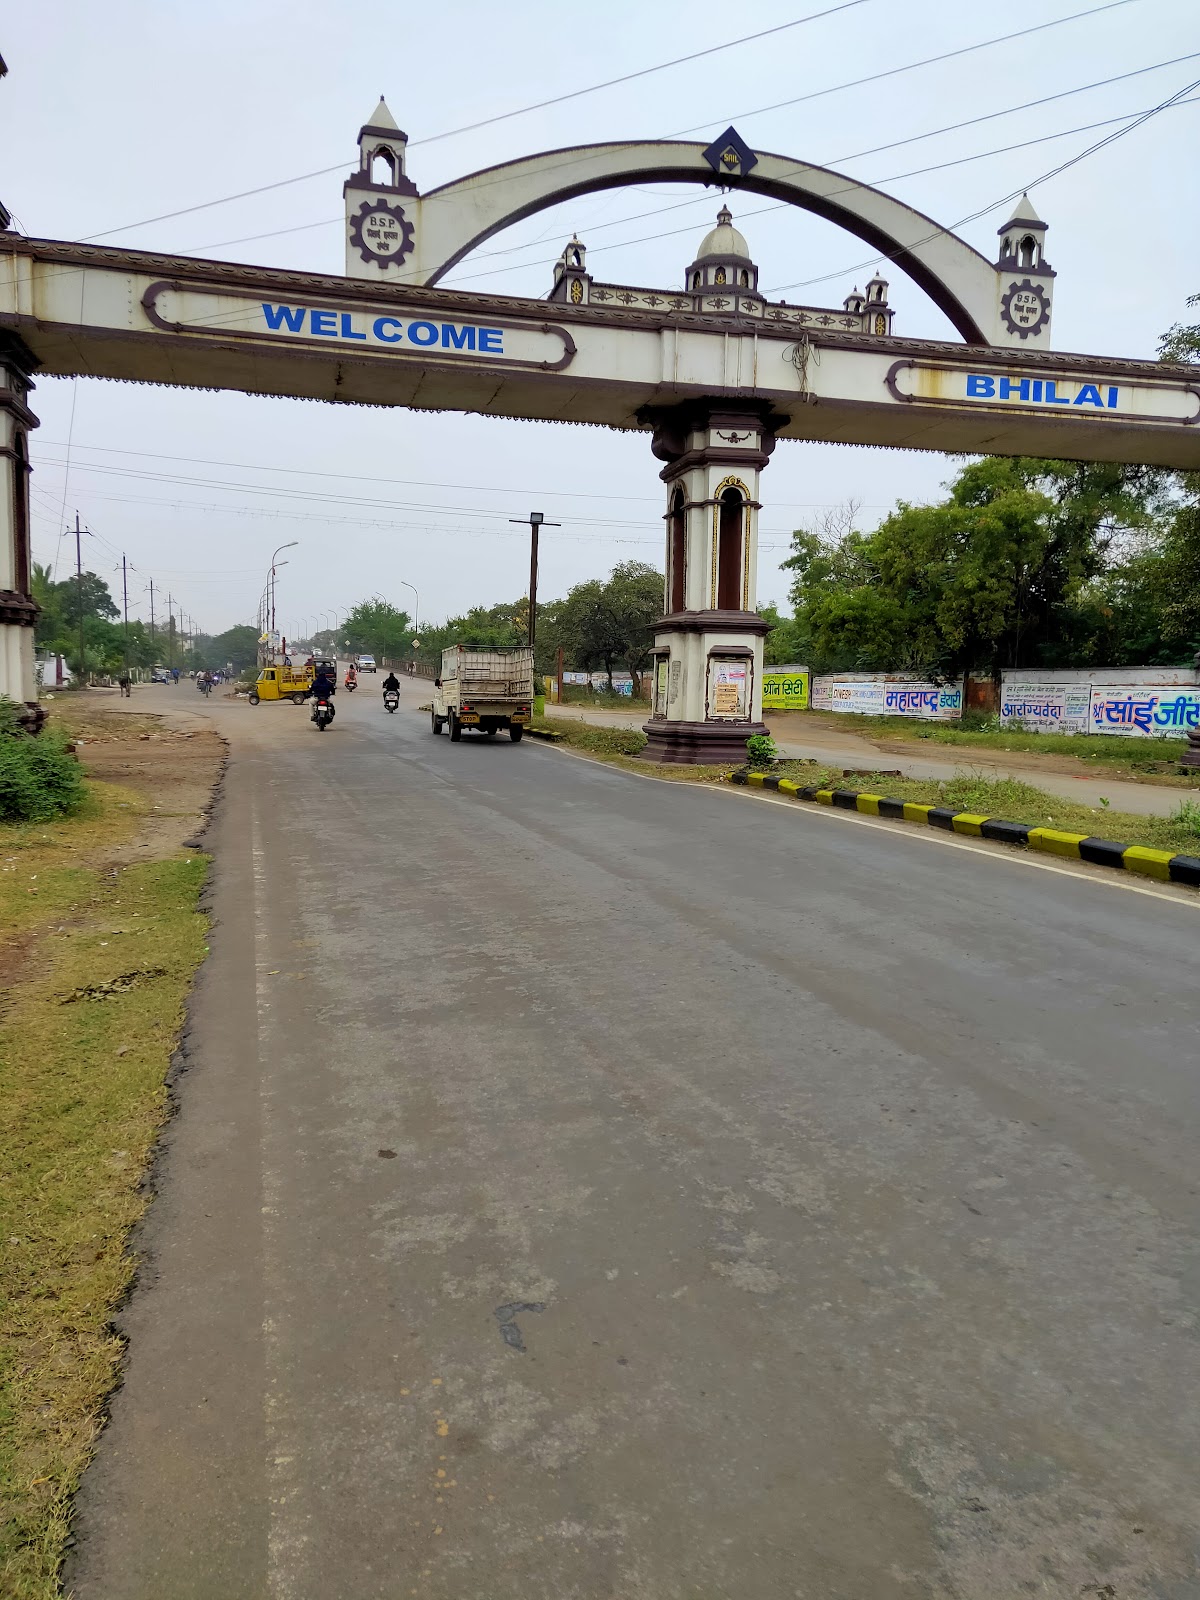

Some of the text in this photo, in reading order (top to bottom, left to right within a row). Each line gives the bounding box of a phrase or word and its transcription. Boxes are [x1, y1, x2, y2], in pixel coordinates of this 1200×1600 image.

[723, 153, 739, 163] SAIL
[262, 303, 504, 353] WELCOME
[966, 375, 1118, 408] BHILAI
[782, 679, 803, 695] सिटी
[886, 691, 940, 712] महाराष्ट्र
[939, 690, 961, 708] डेयरी
